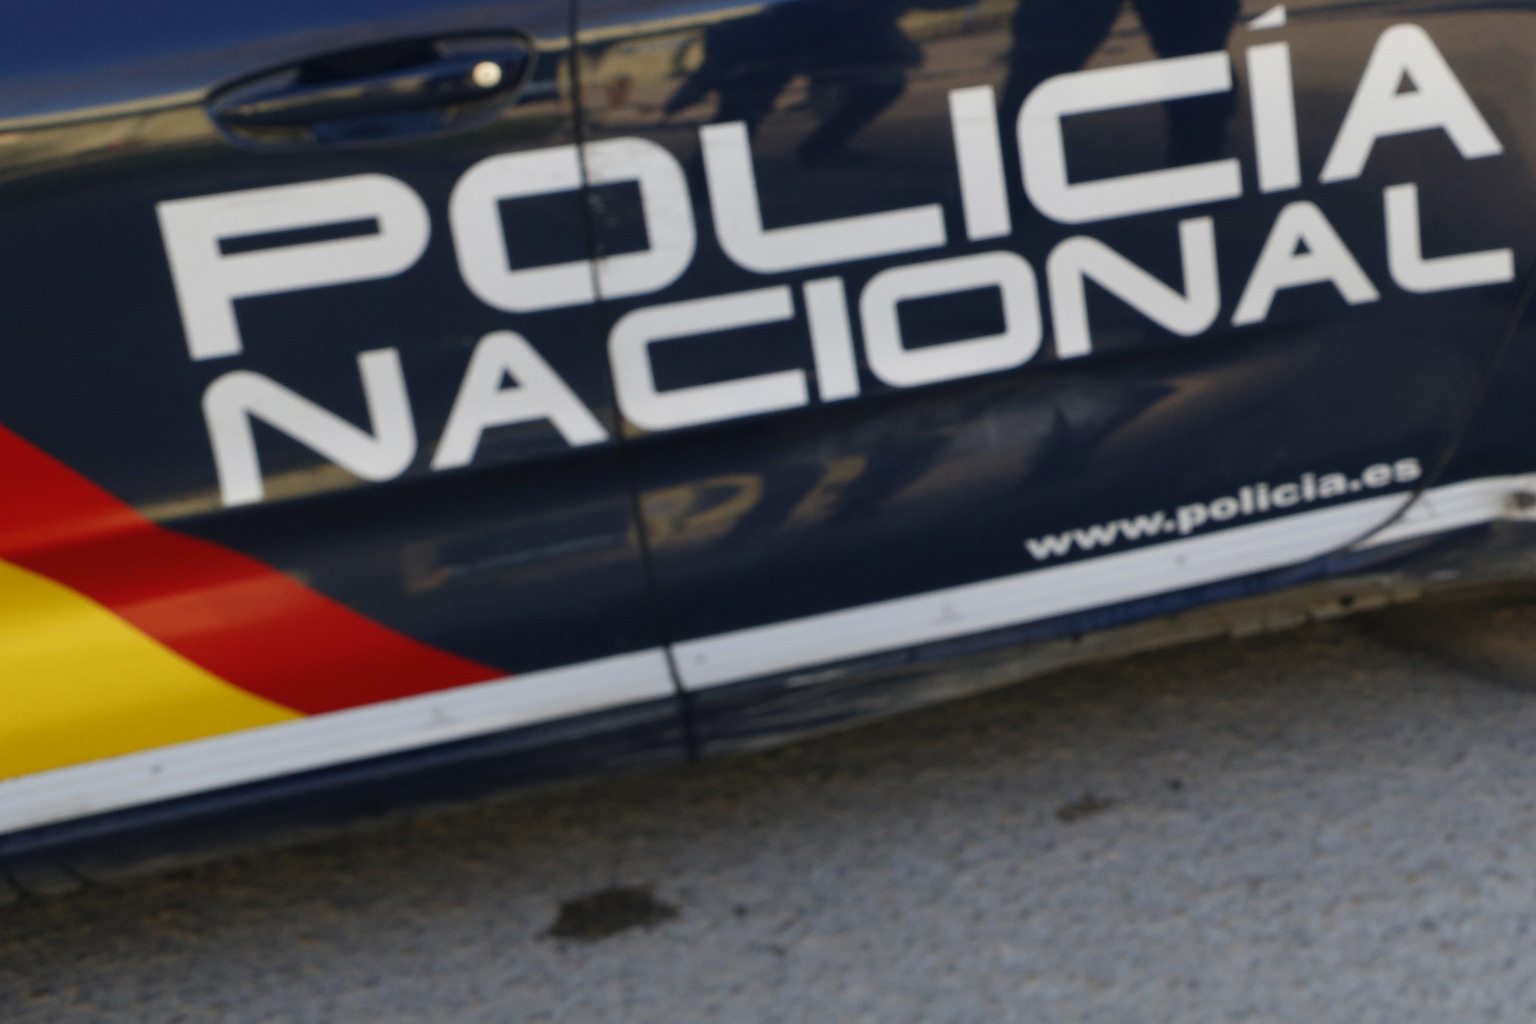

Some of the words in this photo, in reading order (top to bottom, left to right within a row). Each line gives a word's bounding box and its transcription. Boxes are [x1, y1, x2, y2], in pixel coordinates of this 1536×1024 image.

[157, 5, 1503, 360] POLICÍA
[203, 183, 1514, 506] NACIONAL
[1024, 457, 1421, 560] www.policia.es
